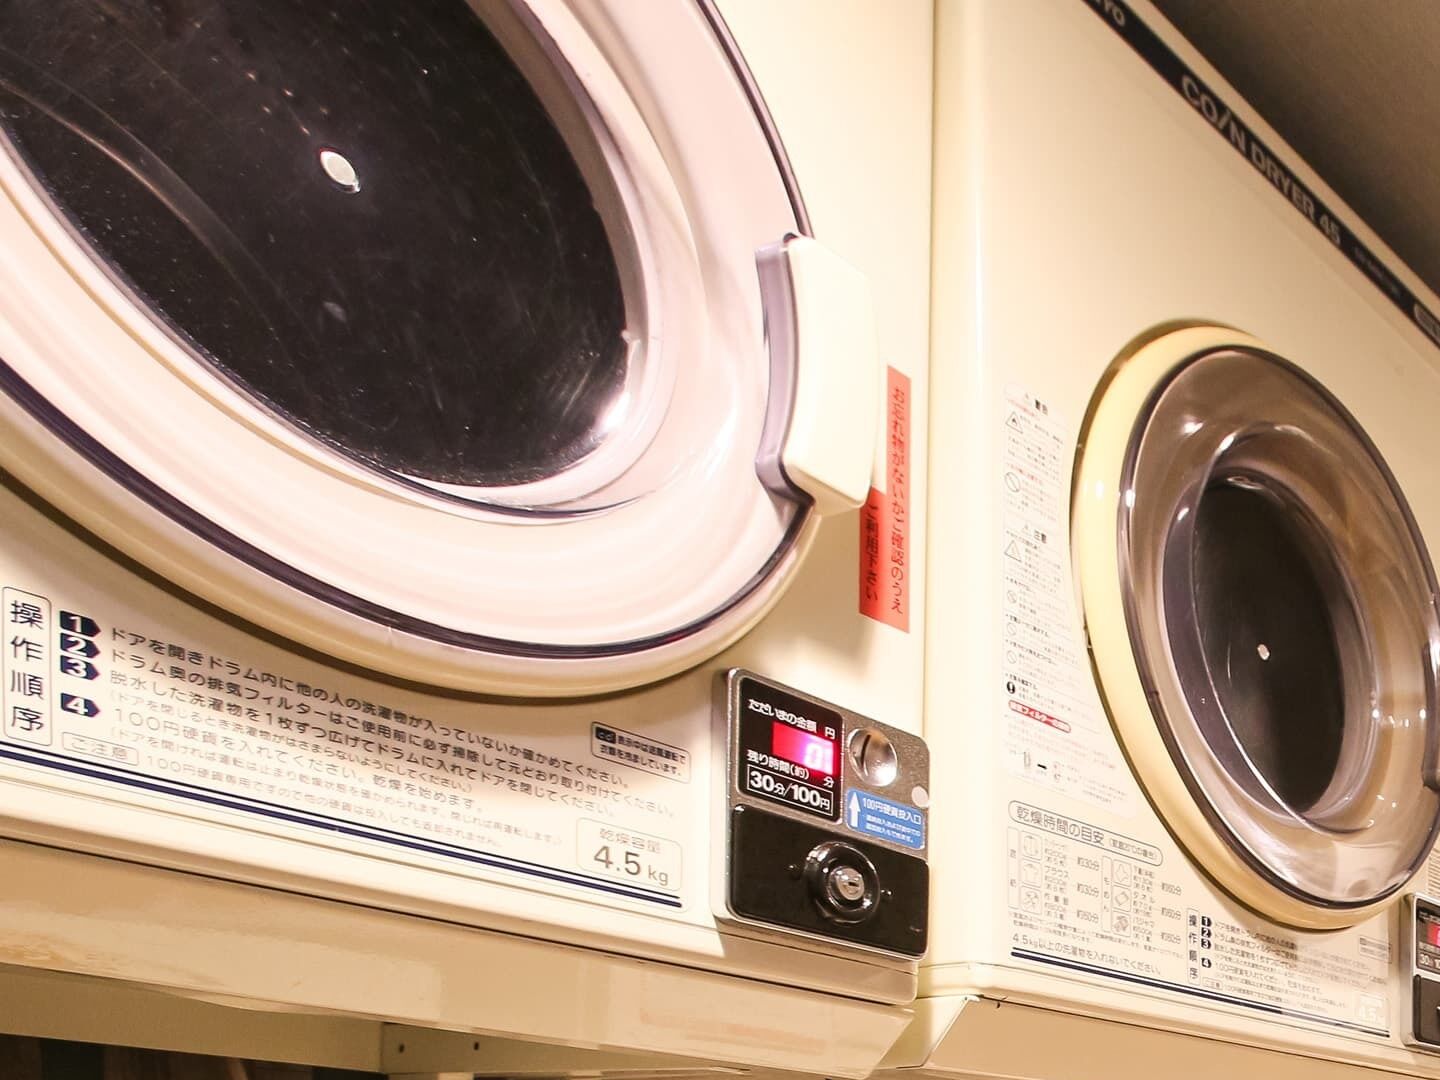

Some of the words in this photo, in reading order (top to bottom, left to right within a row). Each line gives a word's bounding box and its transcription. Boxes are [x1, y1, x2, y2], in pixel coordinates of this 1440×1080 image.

[1251, 146, 1315, 221] DRYER
[1319, 214, 1341, 246] 45
[10, 601, 44, 733] 操作順序
[748, 699, 817, 733] ただいまの金額
[824, 727, 836, 740] 円
[823, 776, 835, 788] 分
[1016, 806, 1105, 847] 乾燥時間の目安
[594, 845, 641, 876] 4.5
[648, 865, 669, 887] kg
